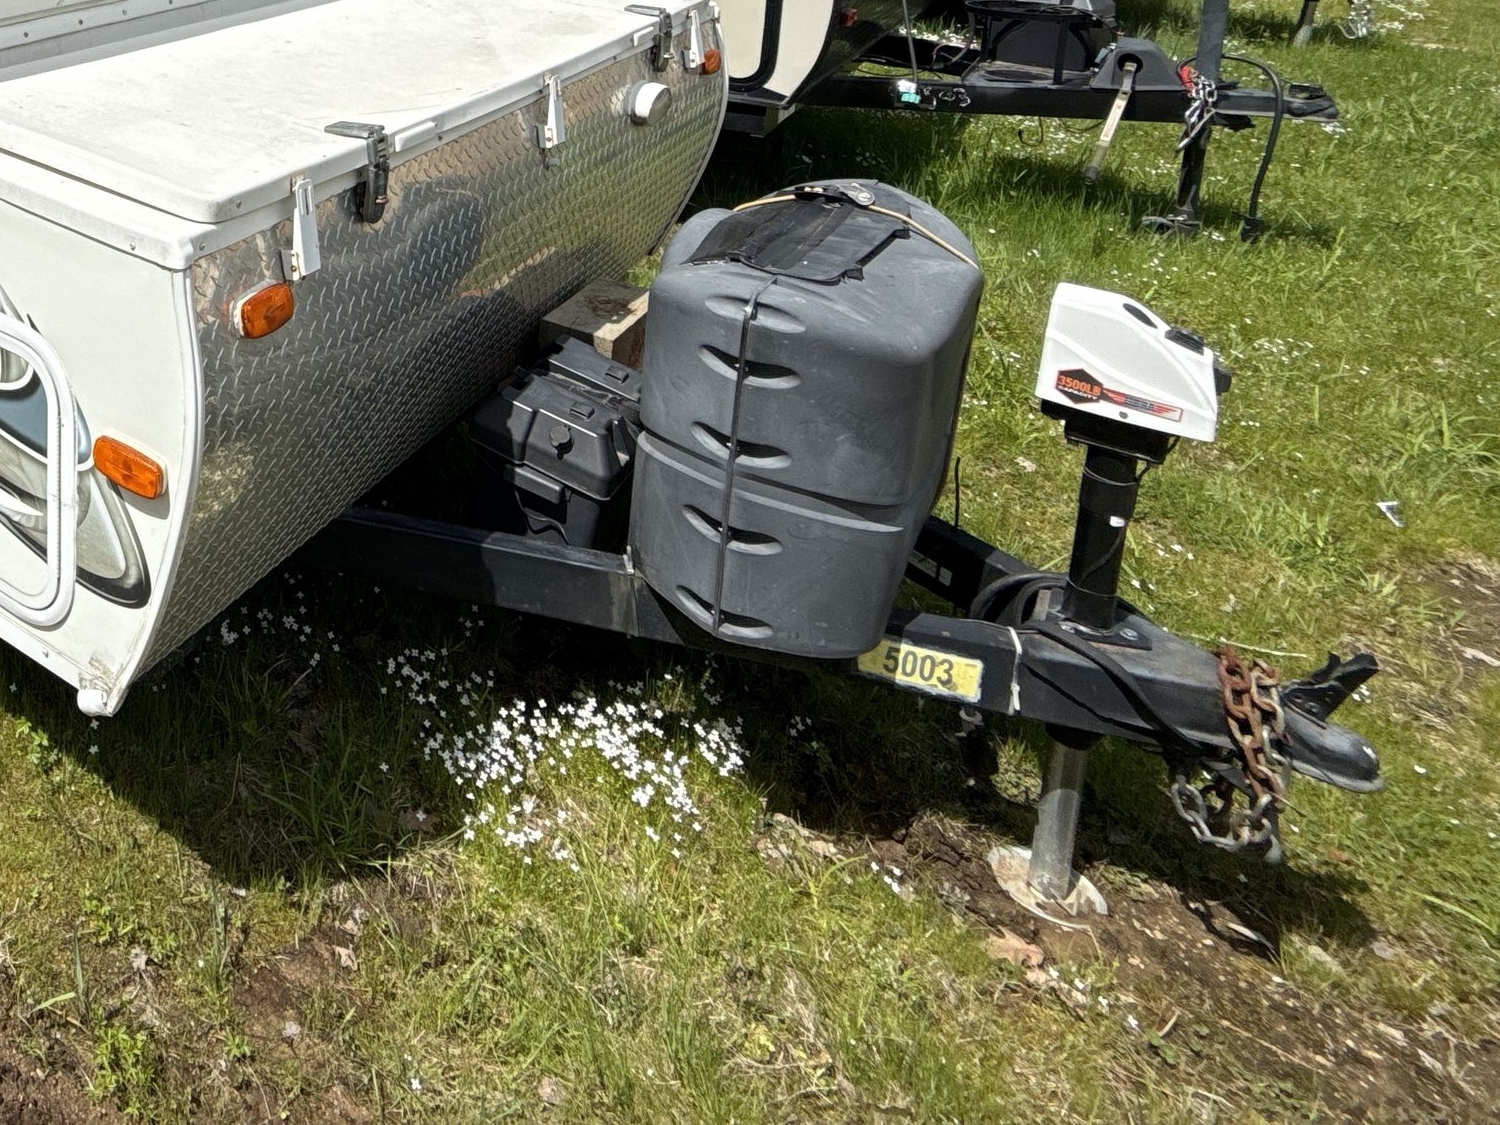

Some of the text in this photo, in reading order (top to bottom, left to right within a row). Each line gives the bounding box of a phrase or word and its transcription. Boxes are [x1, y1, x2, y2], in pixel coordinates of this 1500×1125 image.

[1057, 385, 1098, 401] CAPACITY
[1059, 375, 1101, 396] 3500LB
[883, 647, 954, 686] 5003
